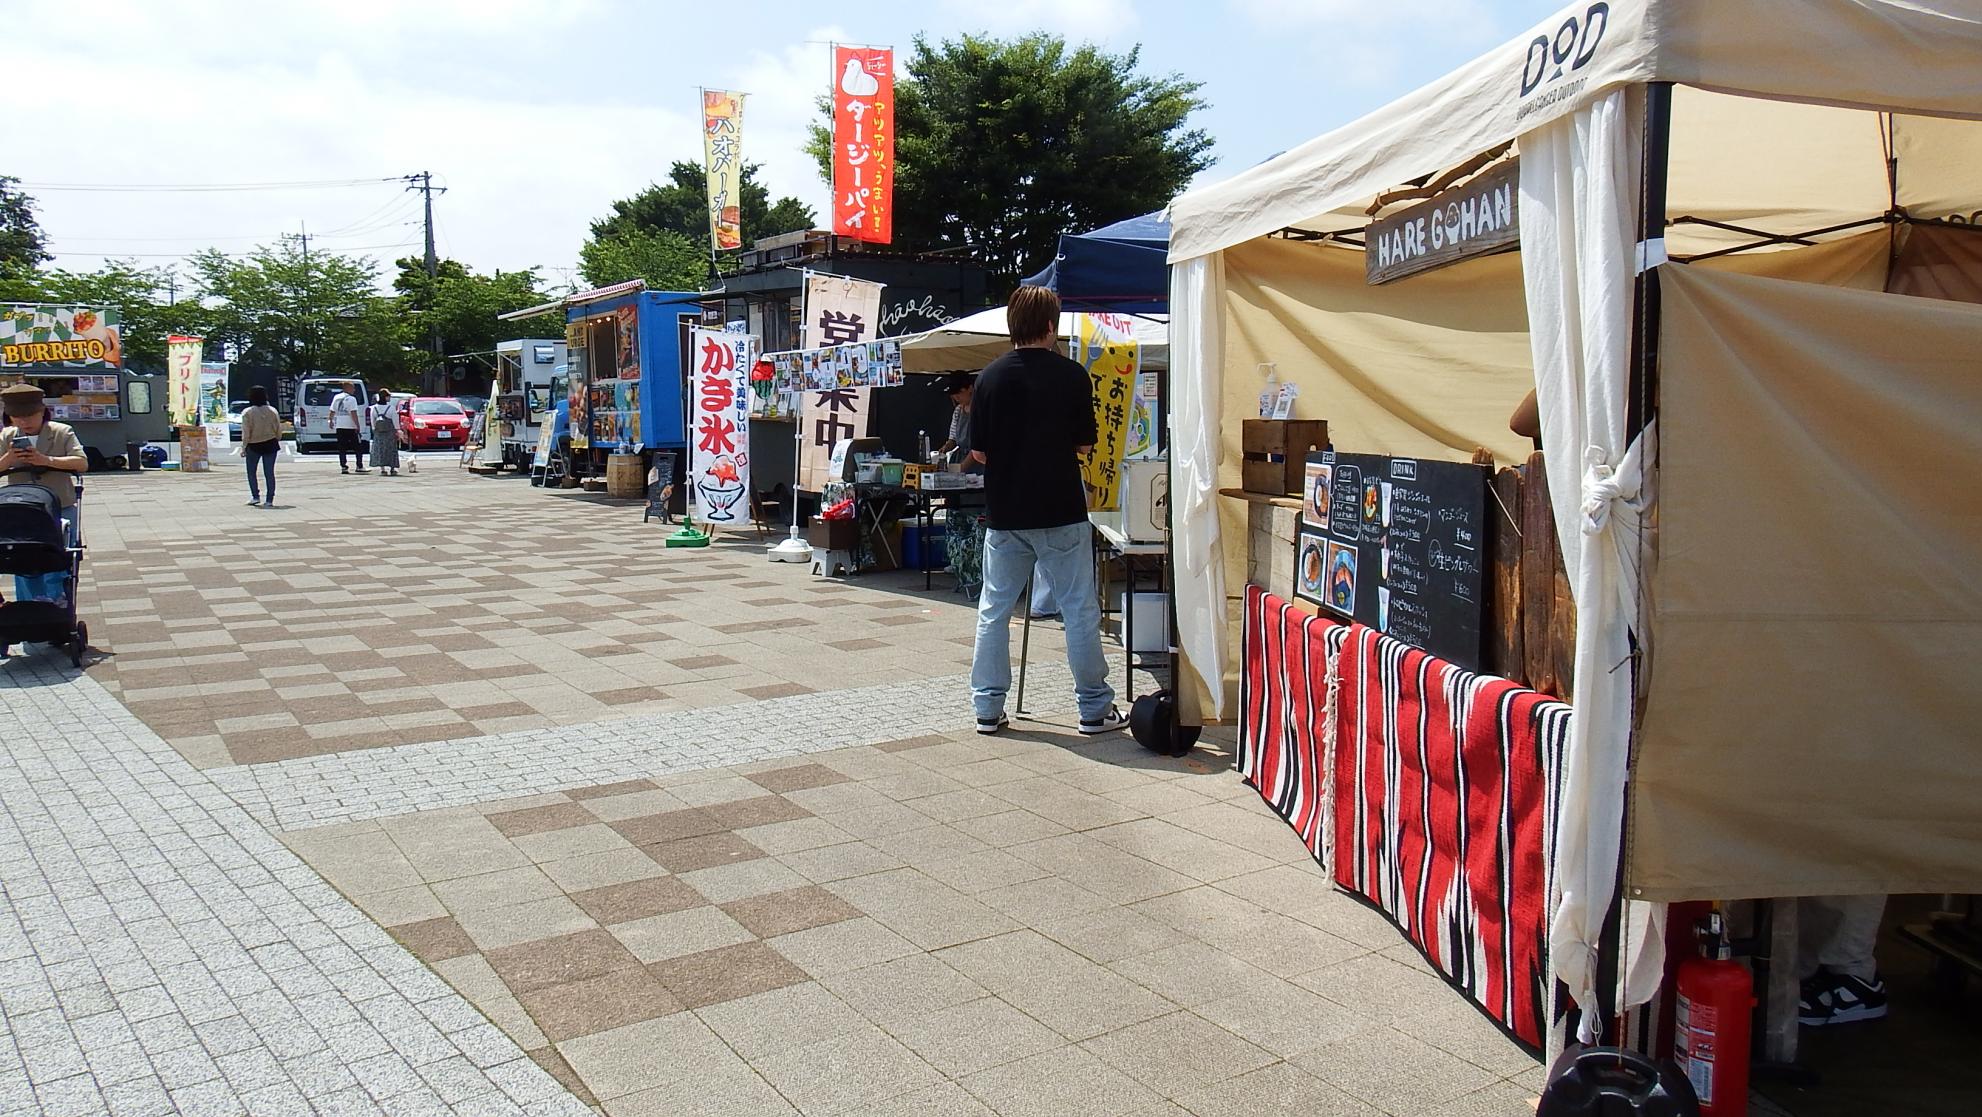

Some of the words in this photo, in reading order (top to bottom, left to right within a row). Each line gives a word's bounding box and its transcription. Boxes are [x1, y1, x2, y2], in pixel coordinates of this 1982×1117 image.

[1379, 217, 1426, 268] HARE
[4, 339, 105, 364] BURRITO
[698, 336, 736, 456] かき氷
[1098, 377, 1128, 507] お持ち帰り
[1392, 462, 1414, 476] DRINK
